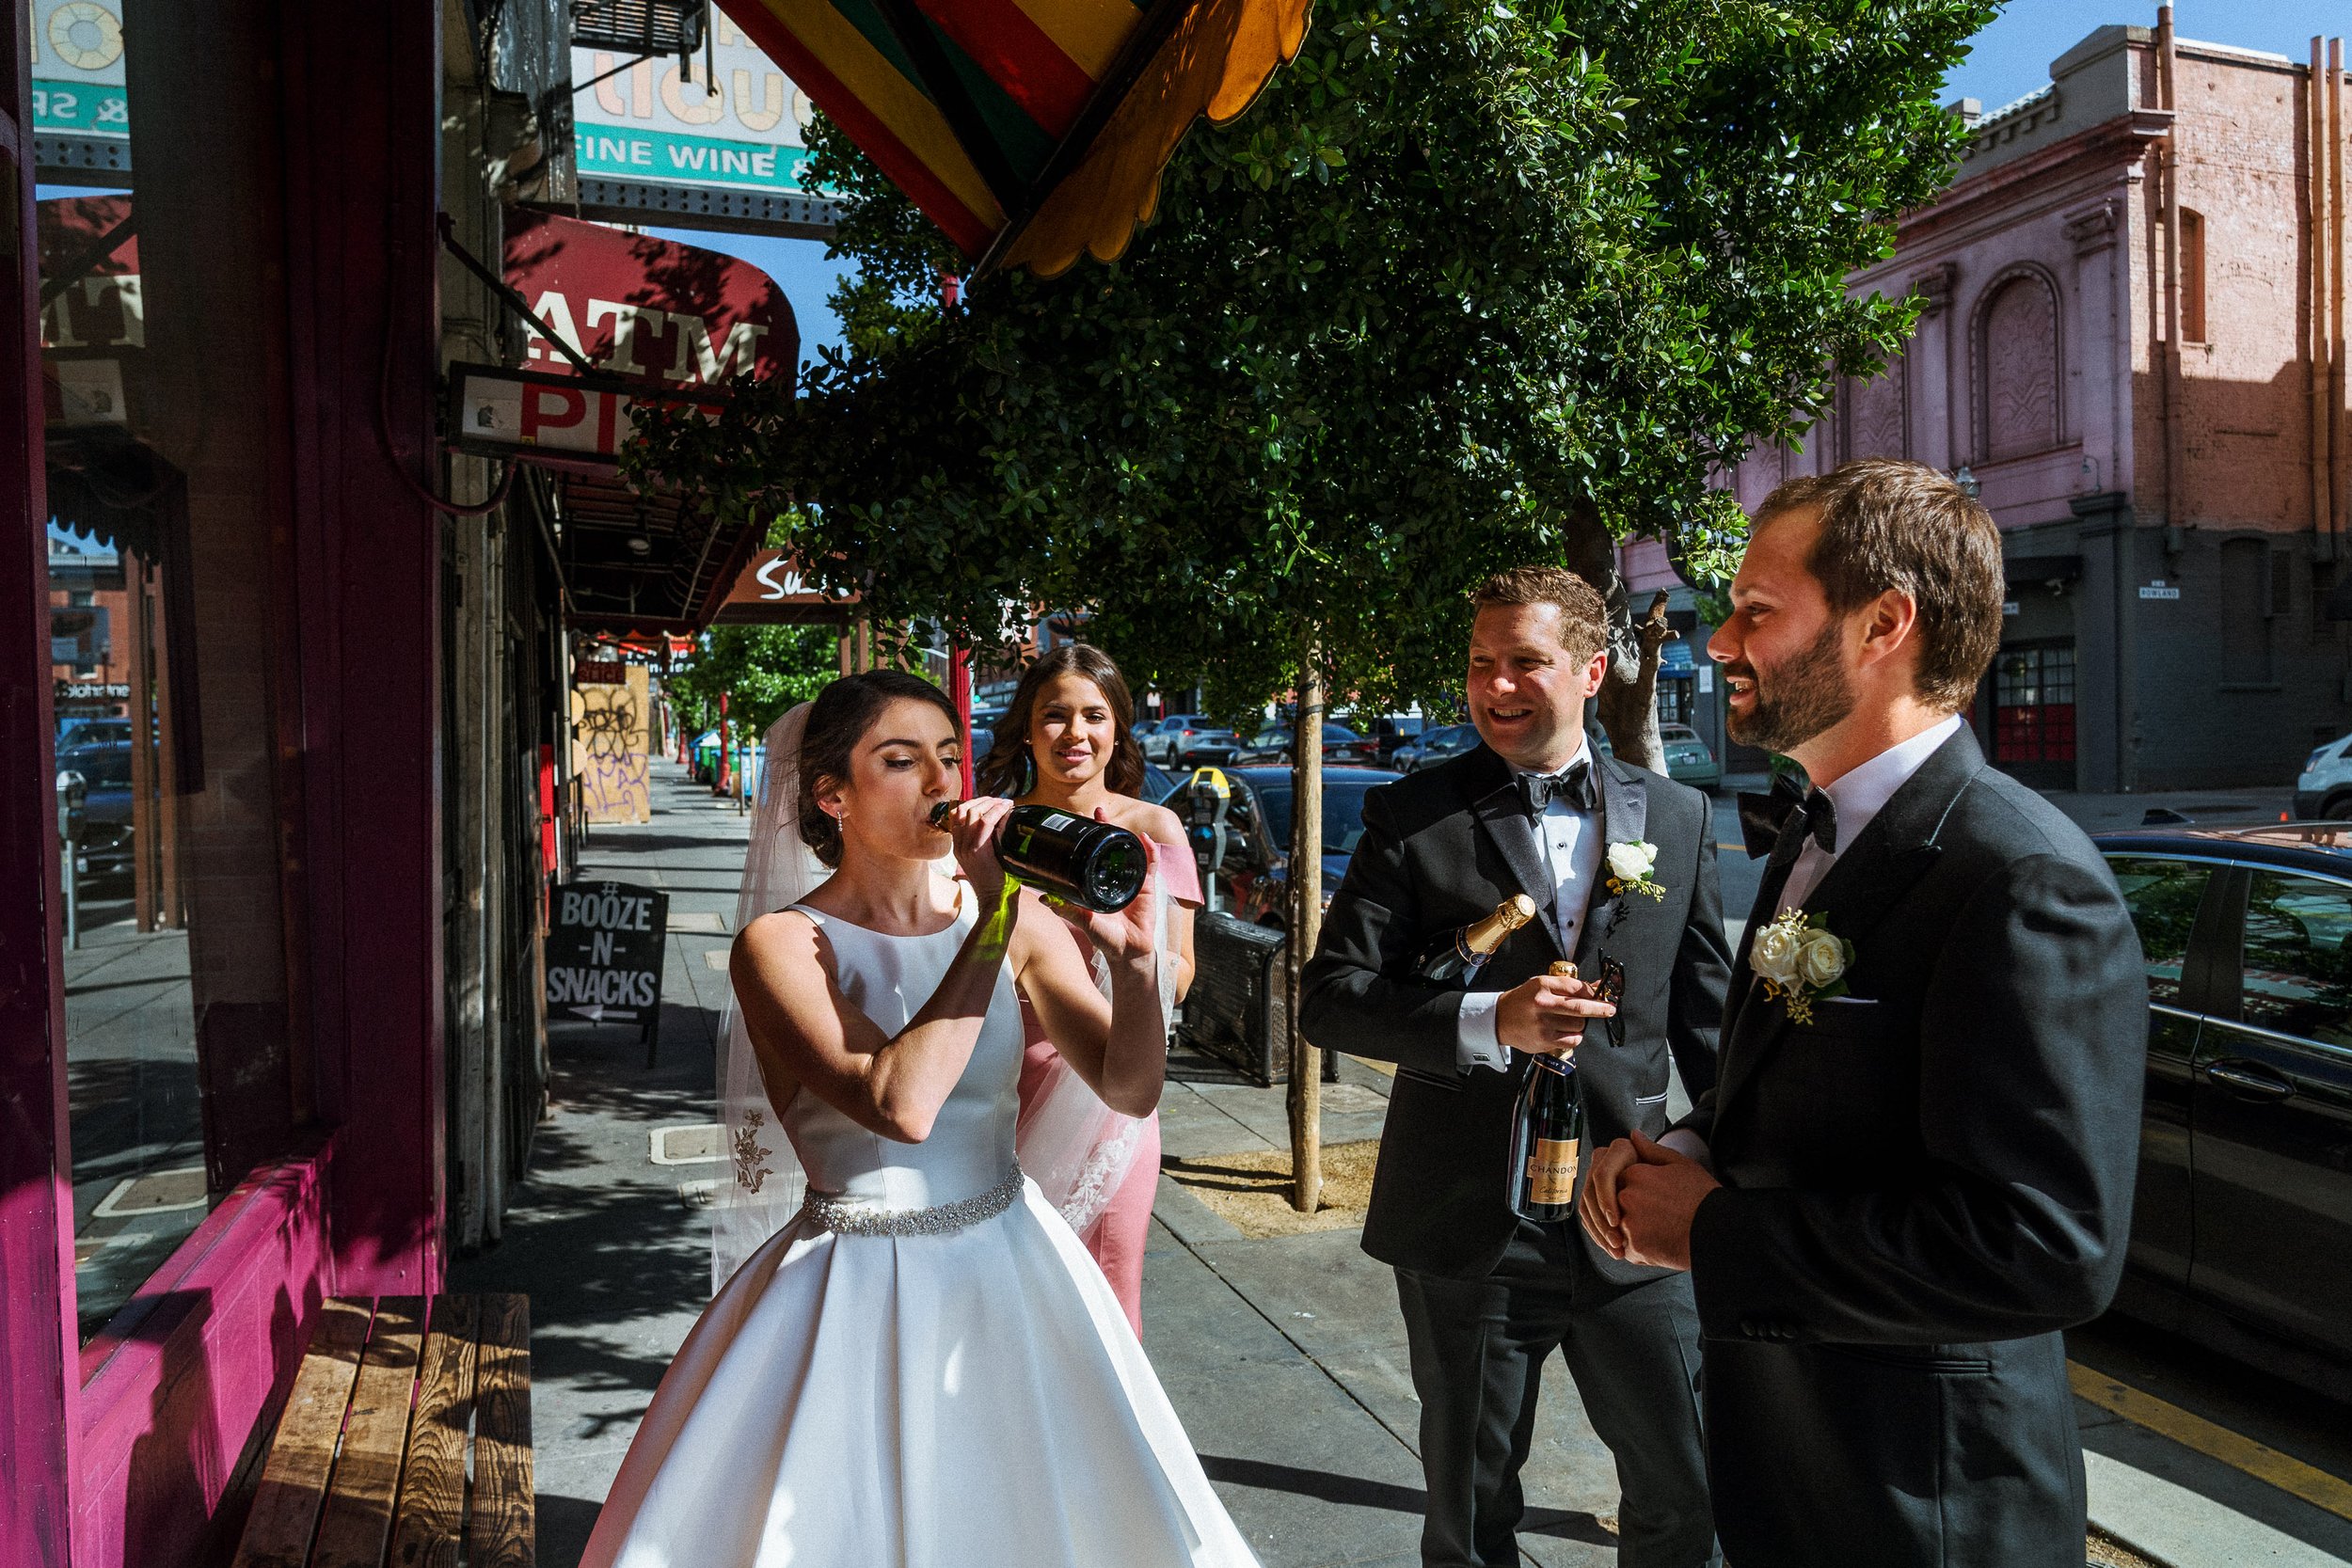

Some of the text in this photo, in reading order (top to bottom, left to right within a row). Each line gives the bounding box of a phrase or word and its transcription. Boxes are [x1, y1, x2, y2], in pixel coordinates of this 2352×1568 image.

[667, 144, 775, 178] WINE
[526, 290, 770, 387] ATM
[561, 892, 653, 931] BOOZE
[547, 966, 656, 1007] SNACKS
